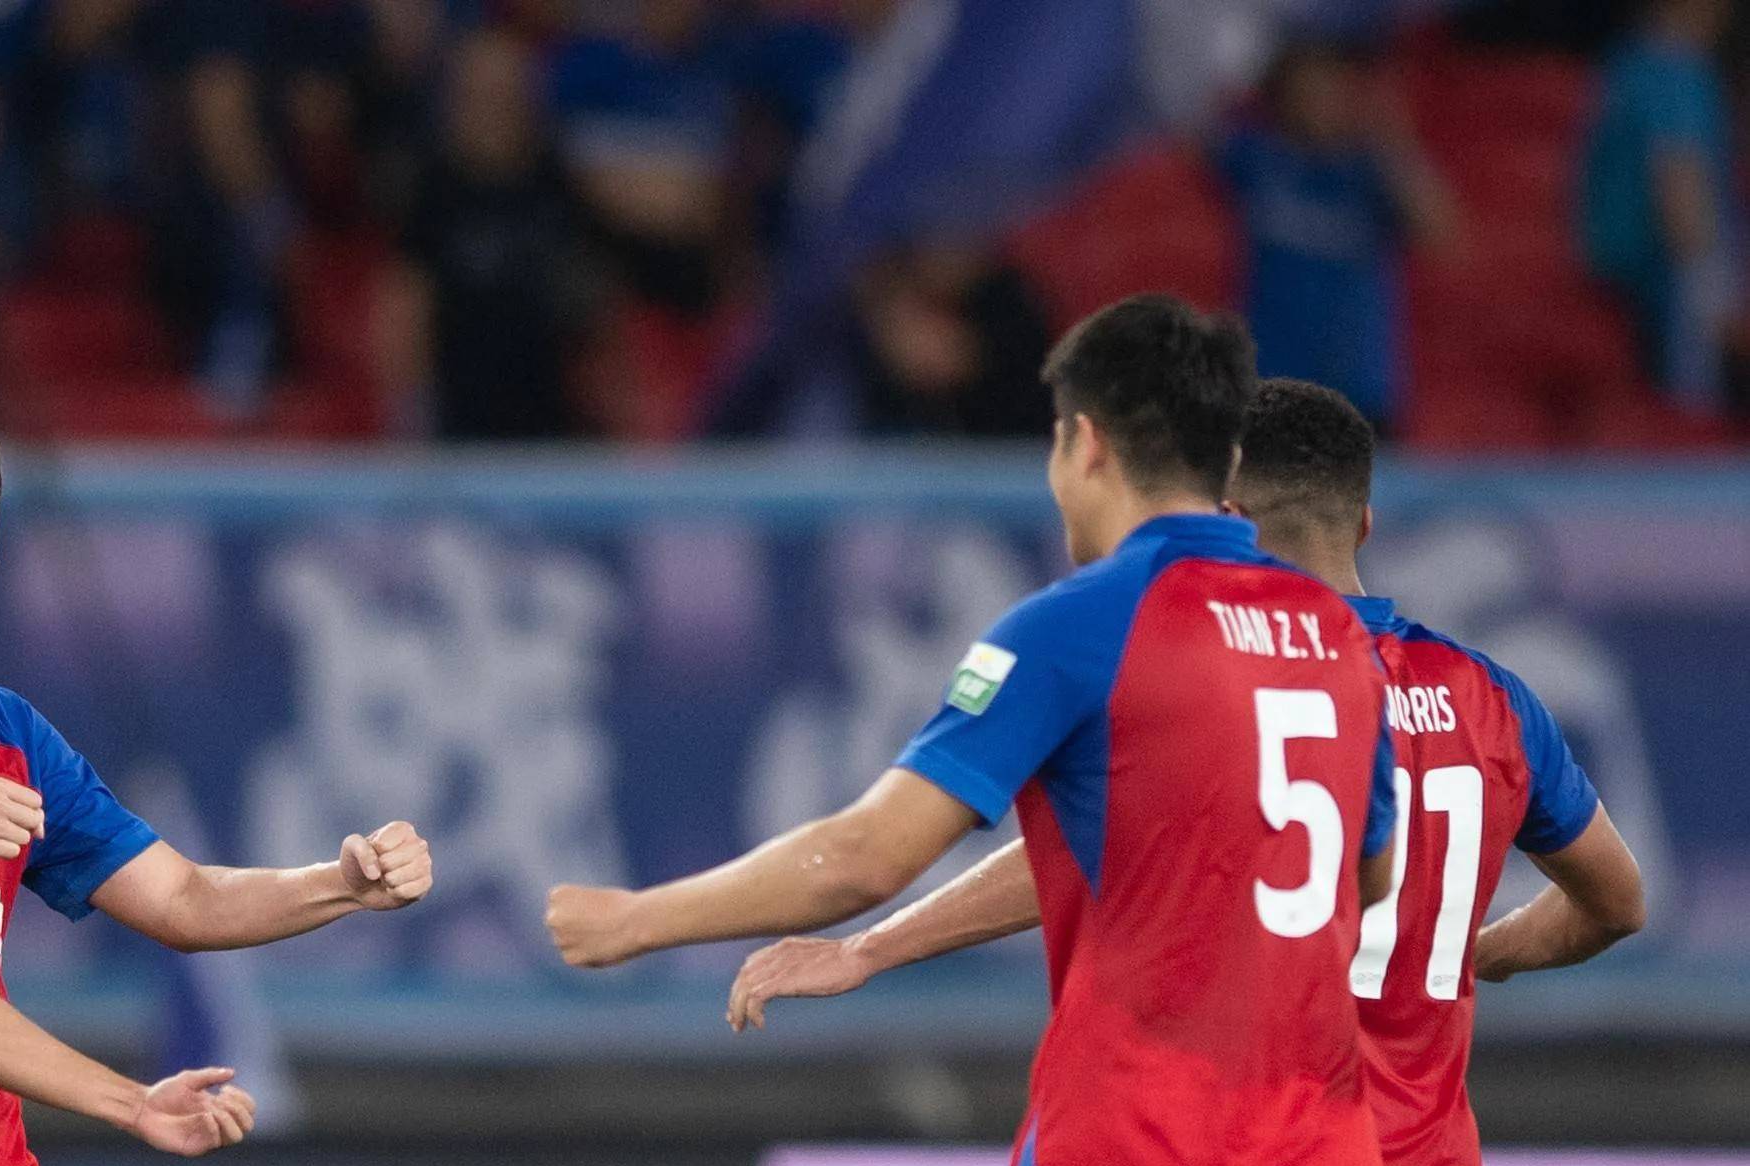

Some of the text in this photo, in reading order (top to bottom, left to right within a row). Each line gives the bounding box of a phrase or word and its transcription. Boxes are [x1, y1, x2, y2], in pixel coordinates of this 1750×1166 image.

[1207, 600, 1339, 660] TIAN Z.Y.
[1253, 687, 1343, 938] 5
